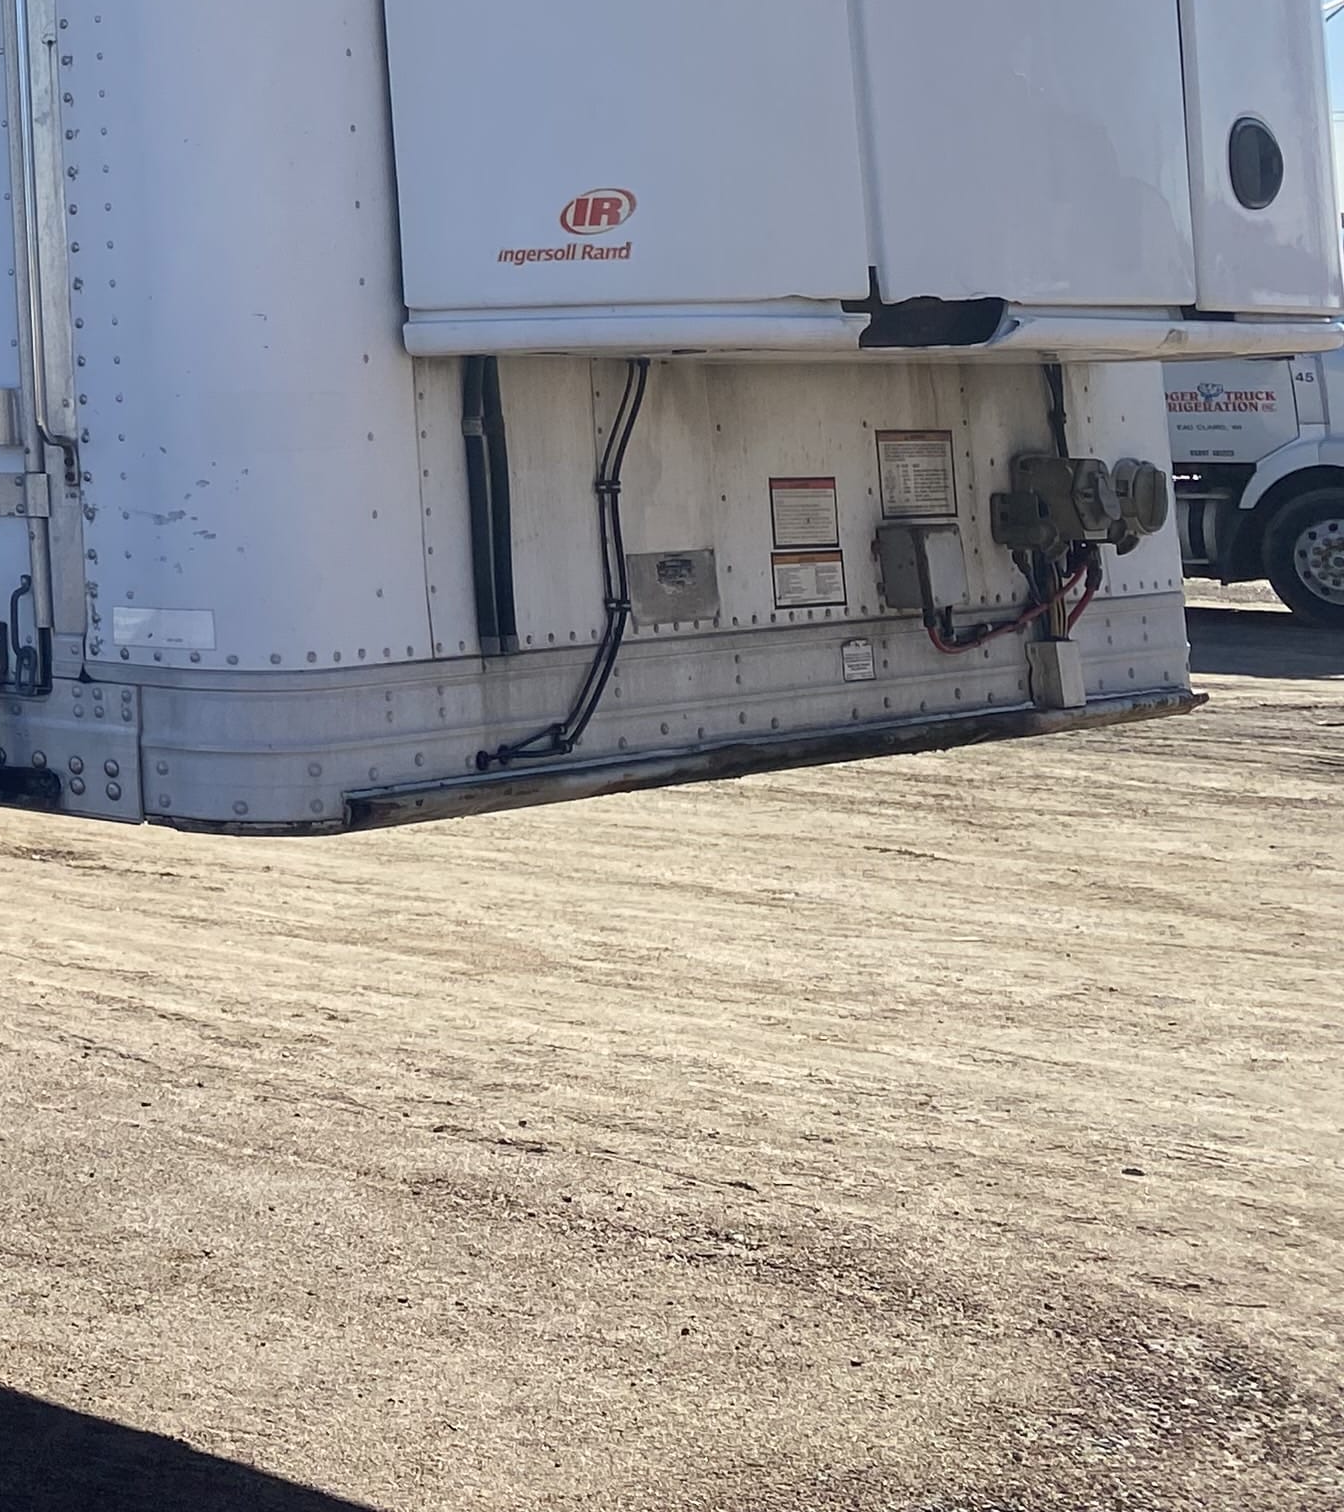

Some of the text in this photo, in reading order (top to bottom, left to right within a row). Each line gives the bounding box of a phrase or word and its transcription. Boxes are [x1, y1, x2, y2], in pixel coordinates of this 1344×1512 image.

[572, 197, 623, 227] IR
[581, 241, 633, 261] Rand
[1295, 372, 1315, 383] 45
[1222, 391, 1277, 402] TRUCK
